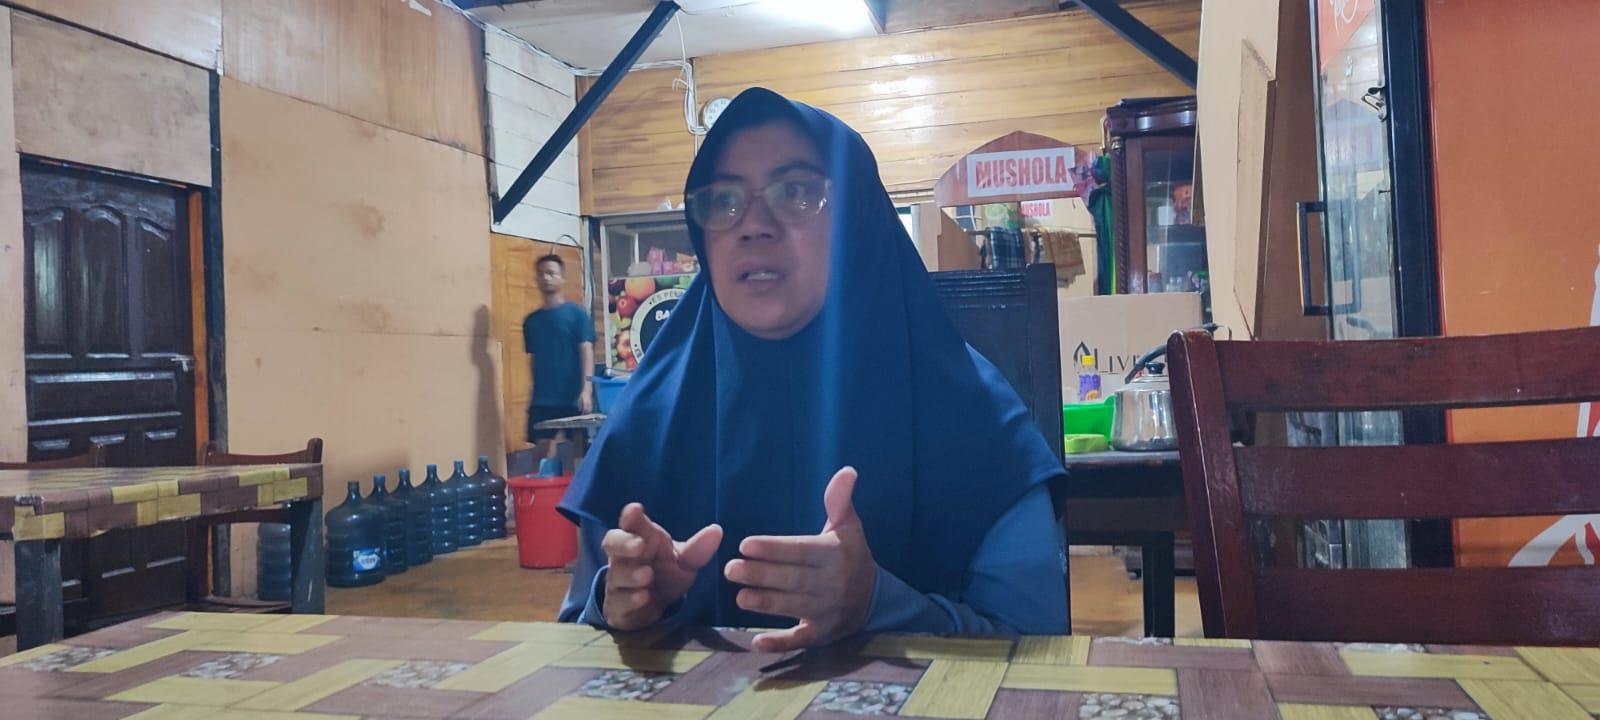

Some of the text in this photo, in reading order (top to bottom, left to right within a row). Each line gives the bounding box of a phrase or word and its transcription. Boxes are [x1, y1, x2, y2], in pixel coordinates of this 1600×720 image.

[976, 156, 1067, 188] MUSHOLA
[1020, 202, 1051, 217] MUSHOLA
[656, 310, 672, 321] BA
